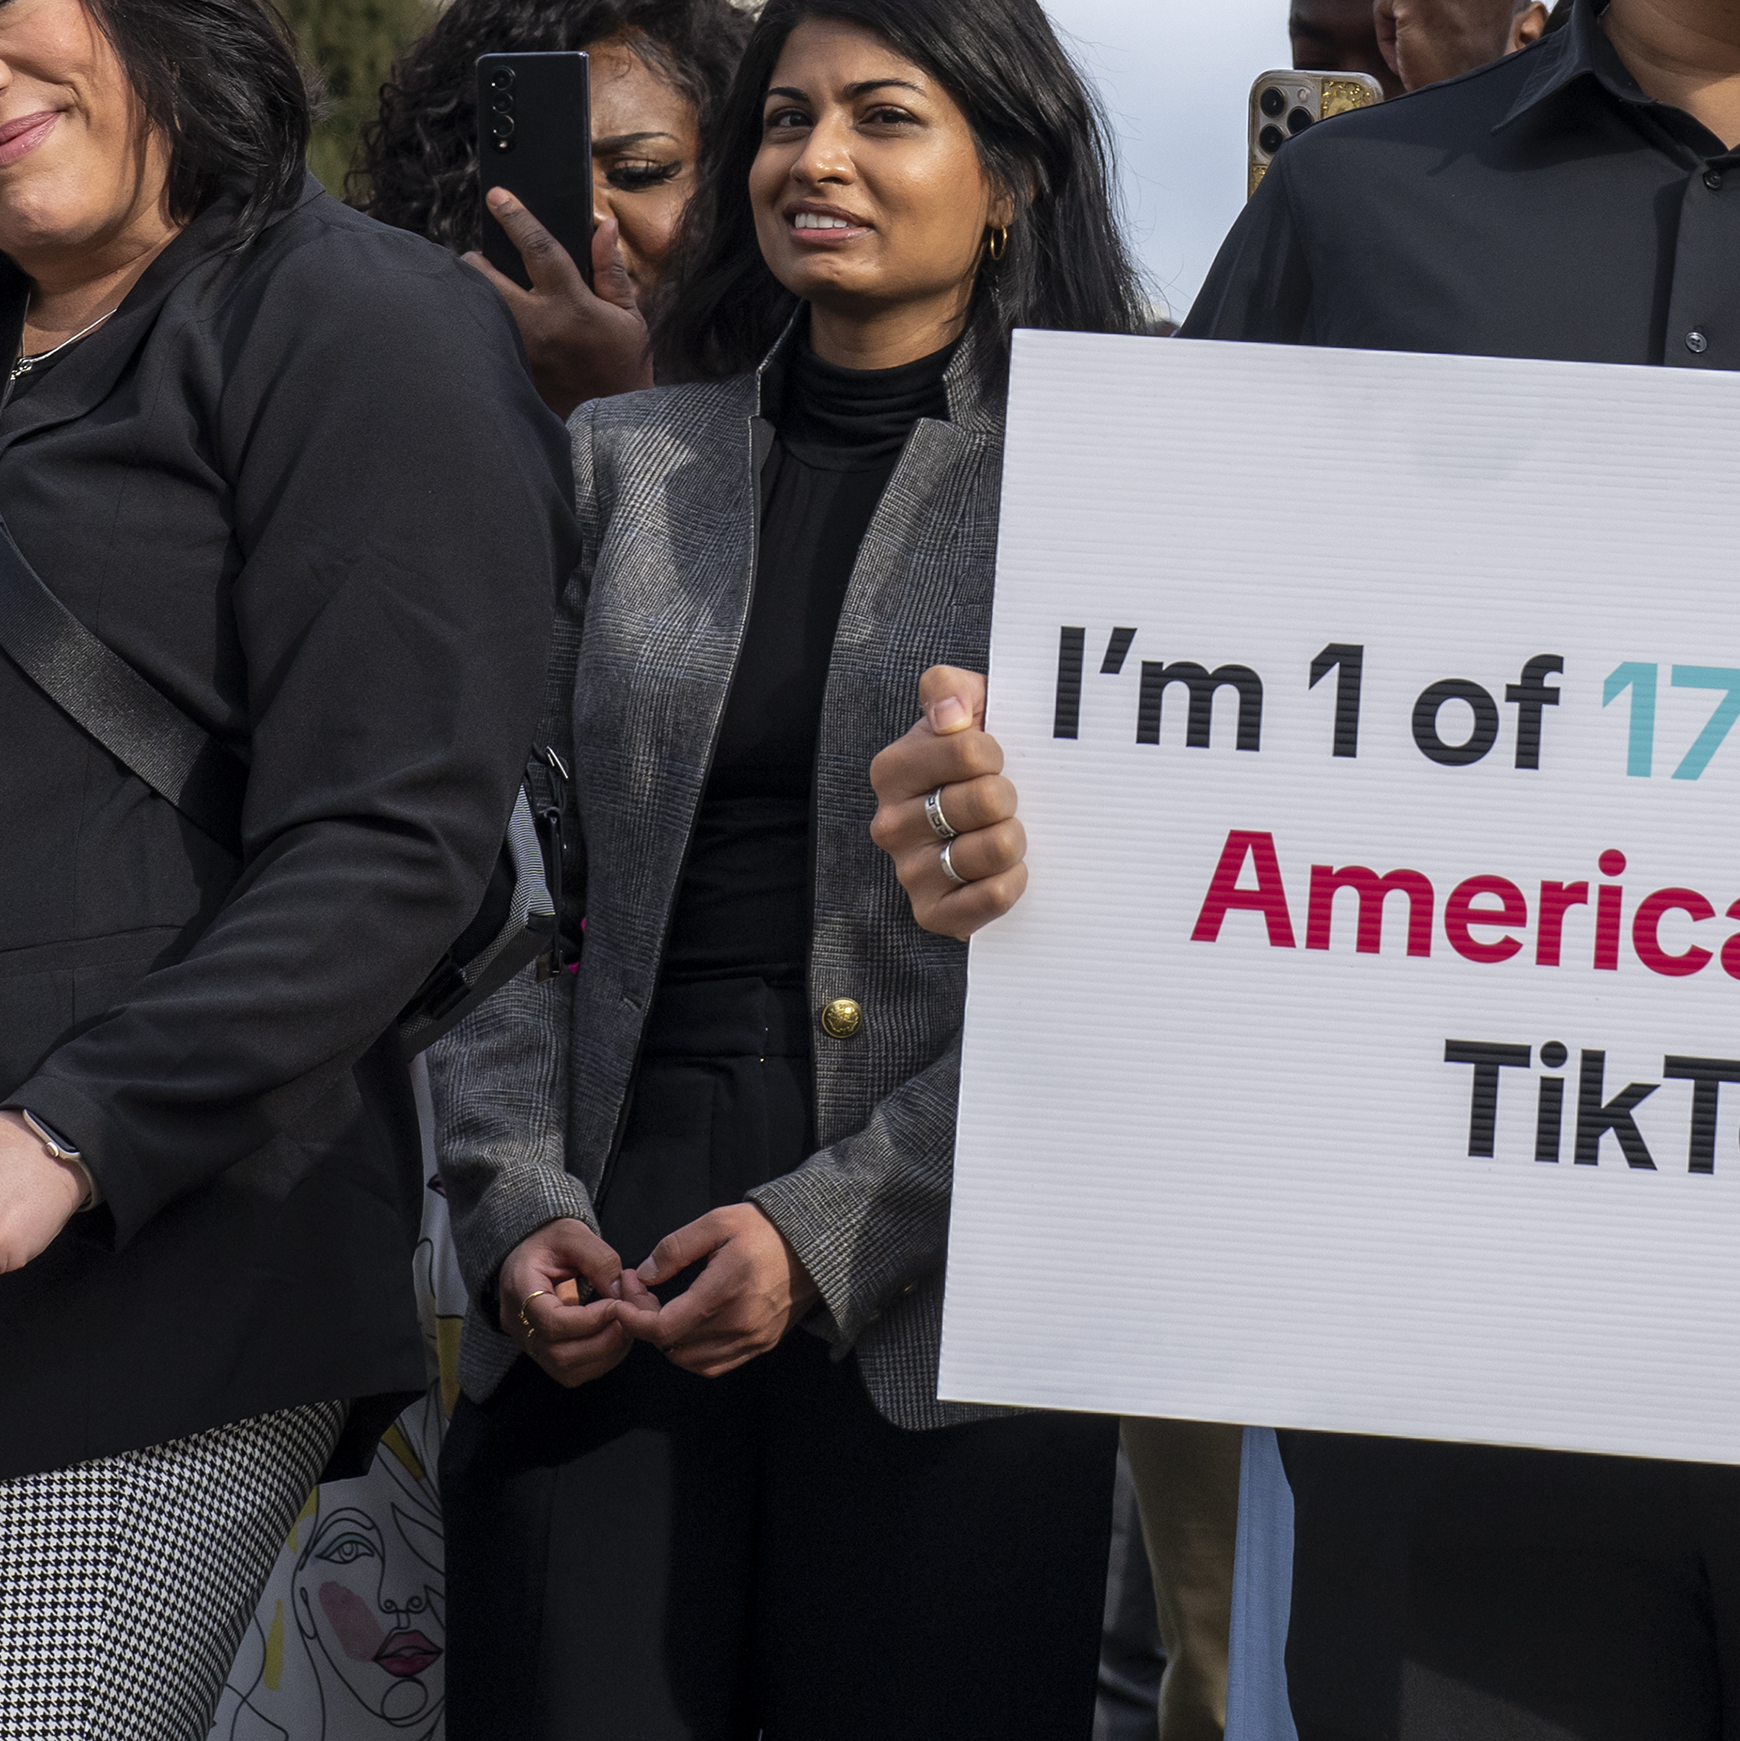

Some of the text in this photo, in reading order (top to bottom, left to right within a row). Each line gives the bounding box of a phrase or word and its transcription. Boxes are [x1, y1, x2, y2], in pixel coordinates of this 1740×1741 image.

[1051, 624, 1265, 753] I'm
[1307, 642, 1365, 760] 1
[1410, 653, 1565, 771] of
